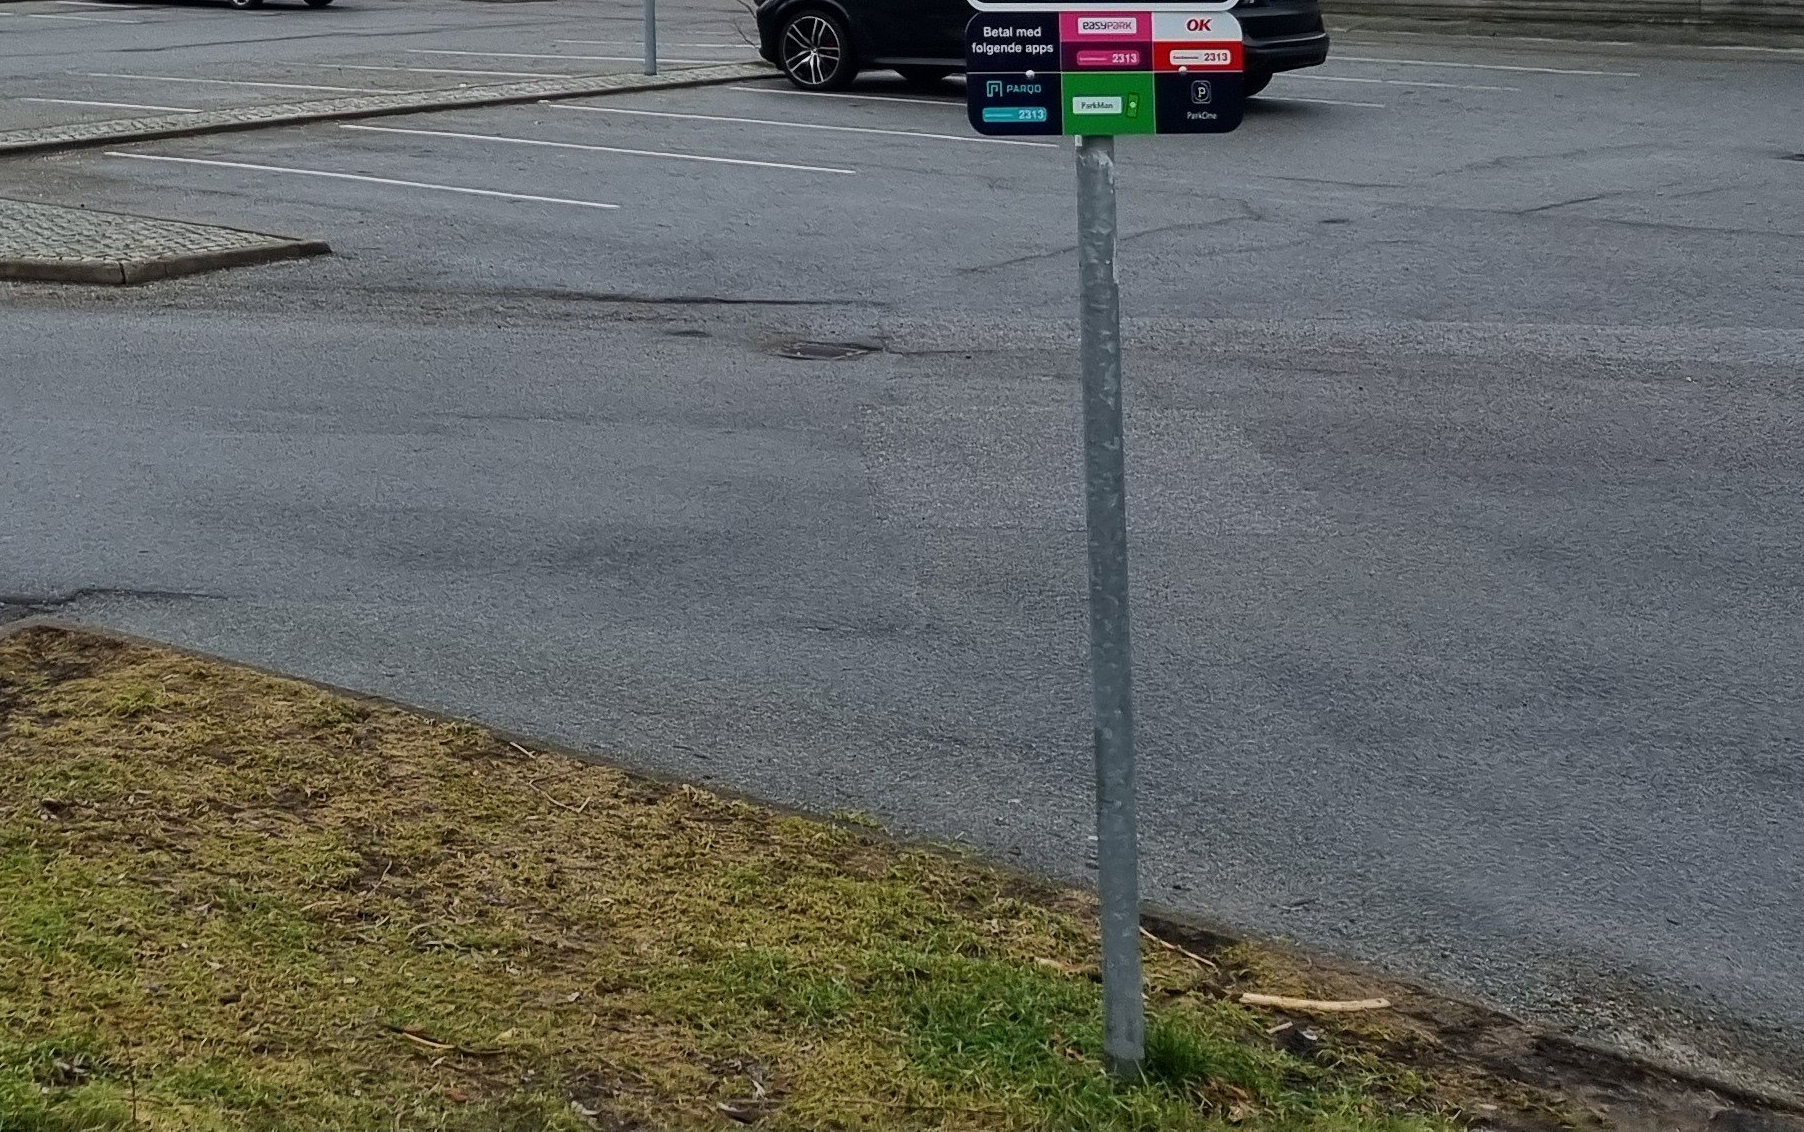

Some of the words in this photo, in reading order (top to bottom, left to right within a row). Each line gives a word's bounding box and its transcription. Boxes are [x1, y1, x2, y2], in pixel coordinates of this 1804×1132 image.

[1186, 18, 1212, 32] OK
[983, 26, 1013, 38] Betal
[1016, 27, 1042, 37] med
[1025, 44, 1054, 55] apps
[1111, 53, 1138, 64] 2313
[1204, 52, 1228, 62] 2313
[1080, 101, 1114, 110] ParkMan
[1018, 109, 1044, 120] 2313
